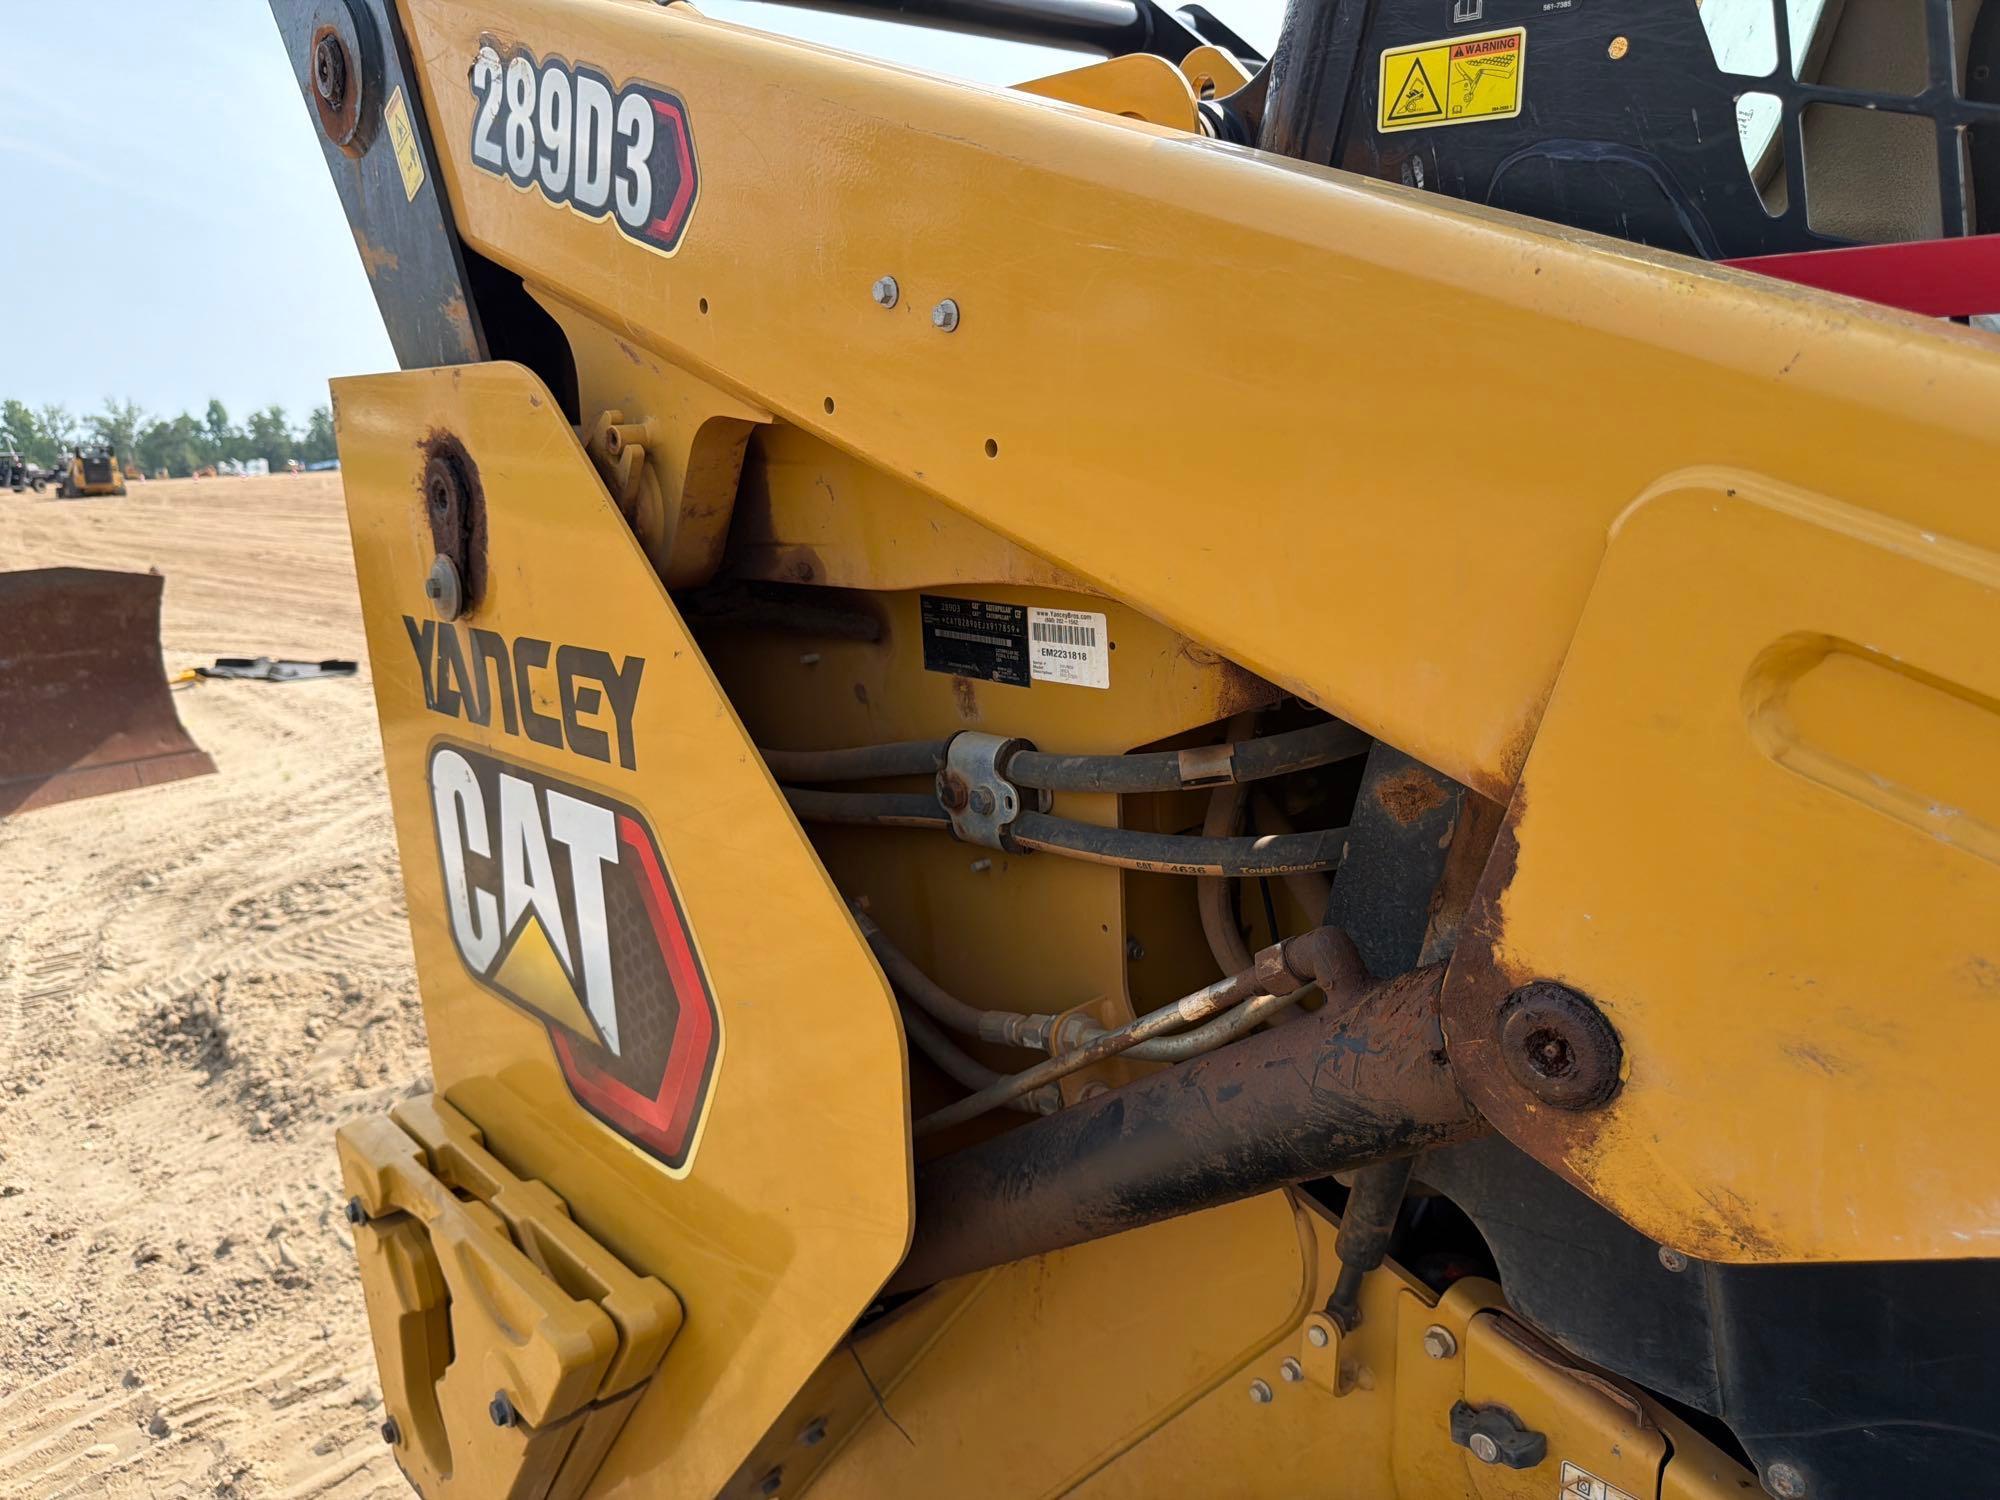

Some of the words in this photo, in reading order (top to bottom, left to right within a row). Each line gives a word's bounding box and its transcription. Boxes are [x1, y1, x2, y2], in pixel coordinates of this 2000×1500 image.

[1465, 38, 1516, 55] WARNING
[474, 46, 655, 227] 289D3
[403, 614, 646, 771] YANCEY
[1041, 647, 1088, 661] EM2231818
[432, 749, 621, 1058] CAT
[1170, 865, 1206, 875] 4636
